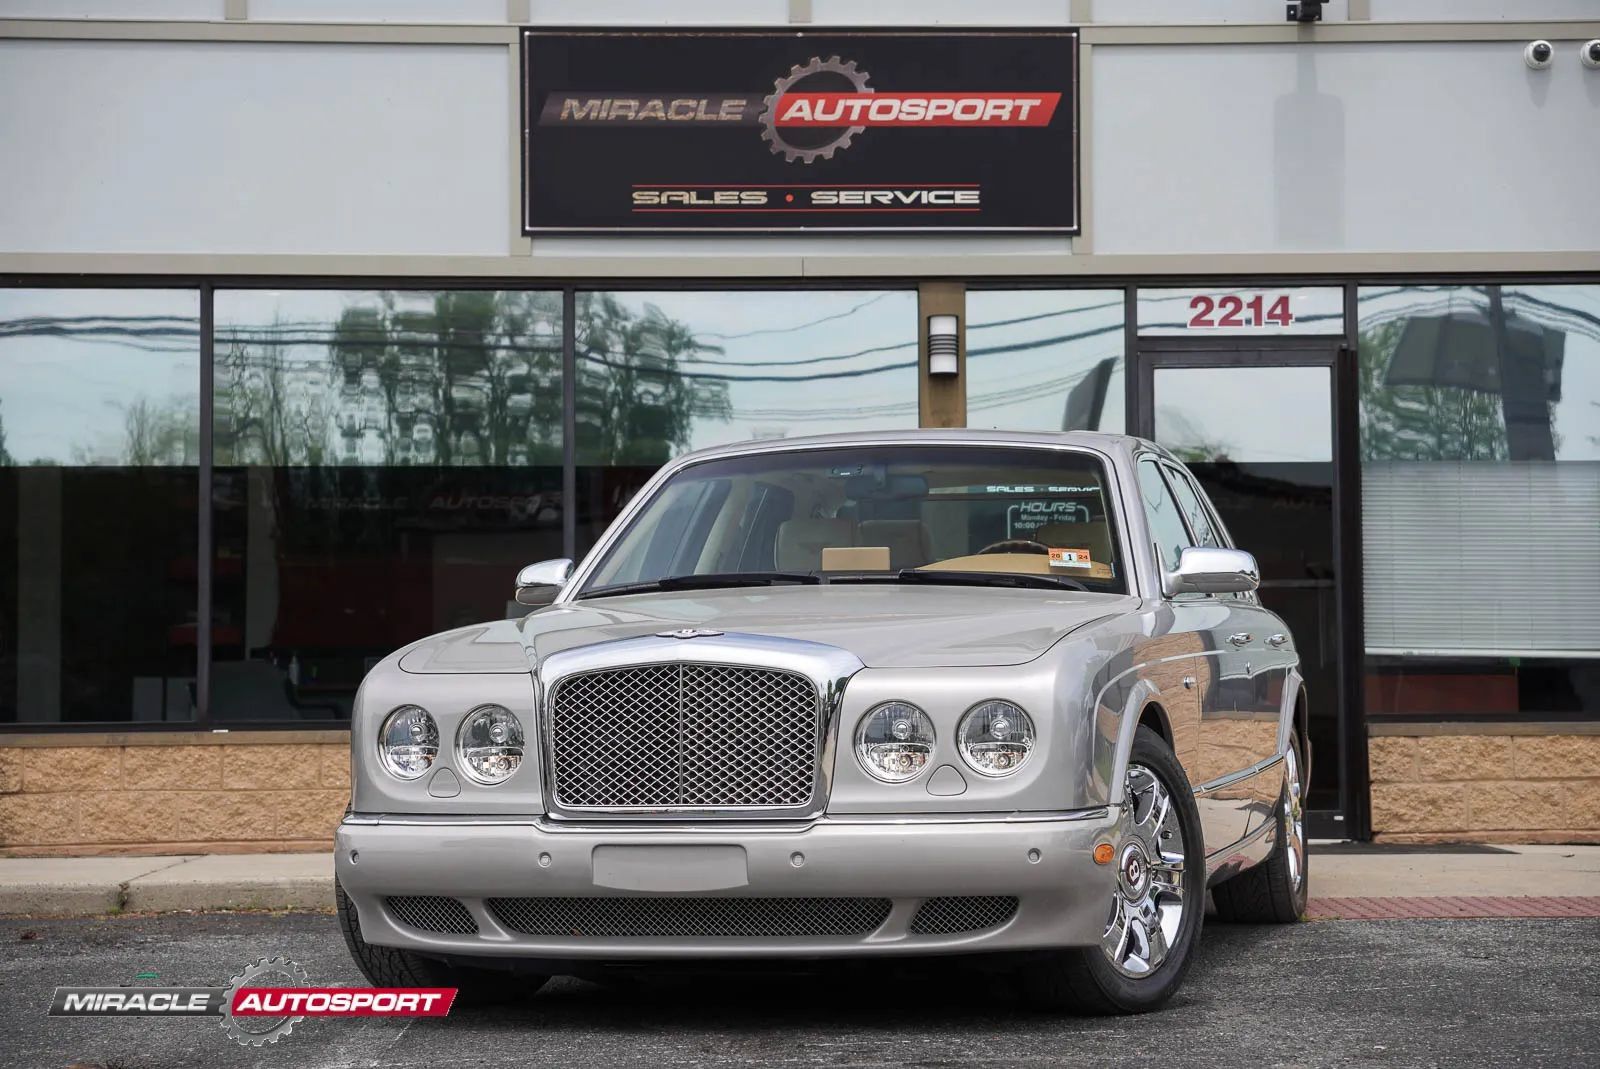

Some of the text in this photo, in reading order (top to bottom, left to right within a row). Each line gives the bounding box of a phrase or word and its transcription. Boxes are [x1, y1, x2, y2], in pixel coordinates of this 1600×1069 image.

[560, 97, 1042, 121] MIRACLE AUTOSPORT
[631, 190, 981, 205] SALES SERVICE
[1188, 295, 1294, 327] 2214
[1020, 502, 1078, 513] HOURS
[1021, 514, 1049, 522] Monday
[1053, 514, 1076, 523] Friday
[1067, 553, 1073, 561] 1
